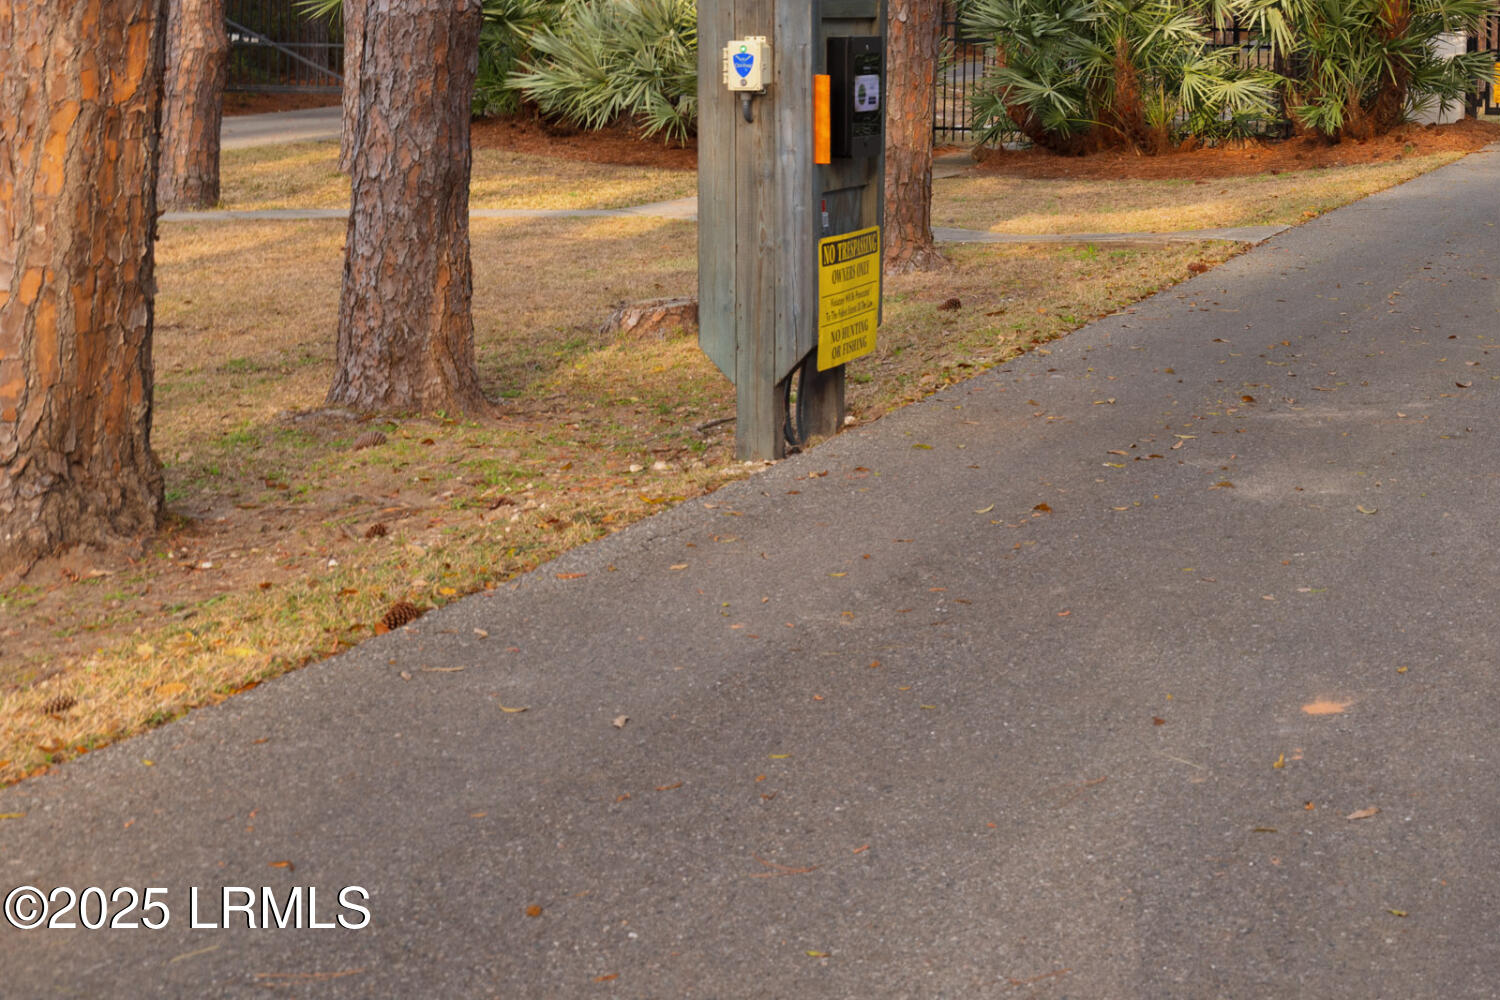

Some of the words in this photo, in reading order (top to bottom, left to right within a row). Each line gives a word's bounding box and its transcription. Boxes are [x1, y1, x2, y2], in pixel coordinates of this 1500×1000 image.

[823, 244, 836, 265] NO
[837, 233, 877, 262] TRESPASSING
[832, 264, 856, 285] OWNERS
[856, 260, 870, 278] ONLY
[831, 329, 841, 343] NO
[842, 318, 869, 340] HUNTING
[832, 345, 841, 360] OR
[843, 336, 867, 356] FISHING
